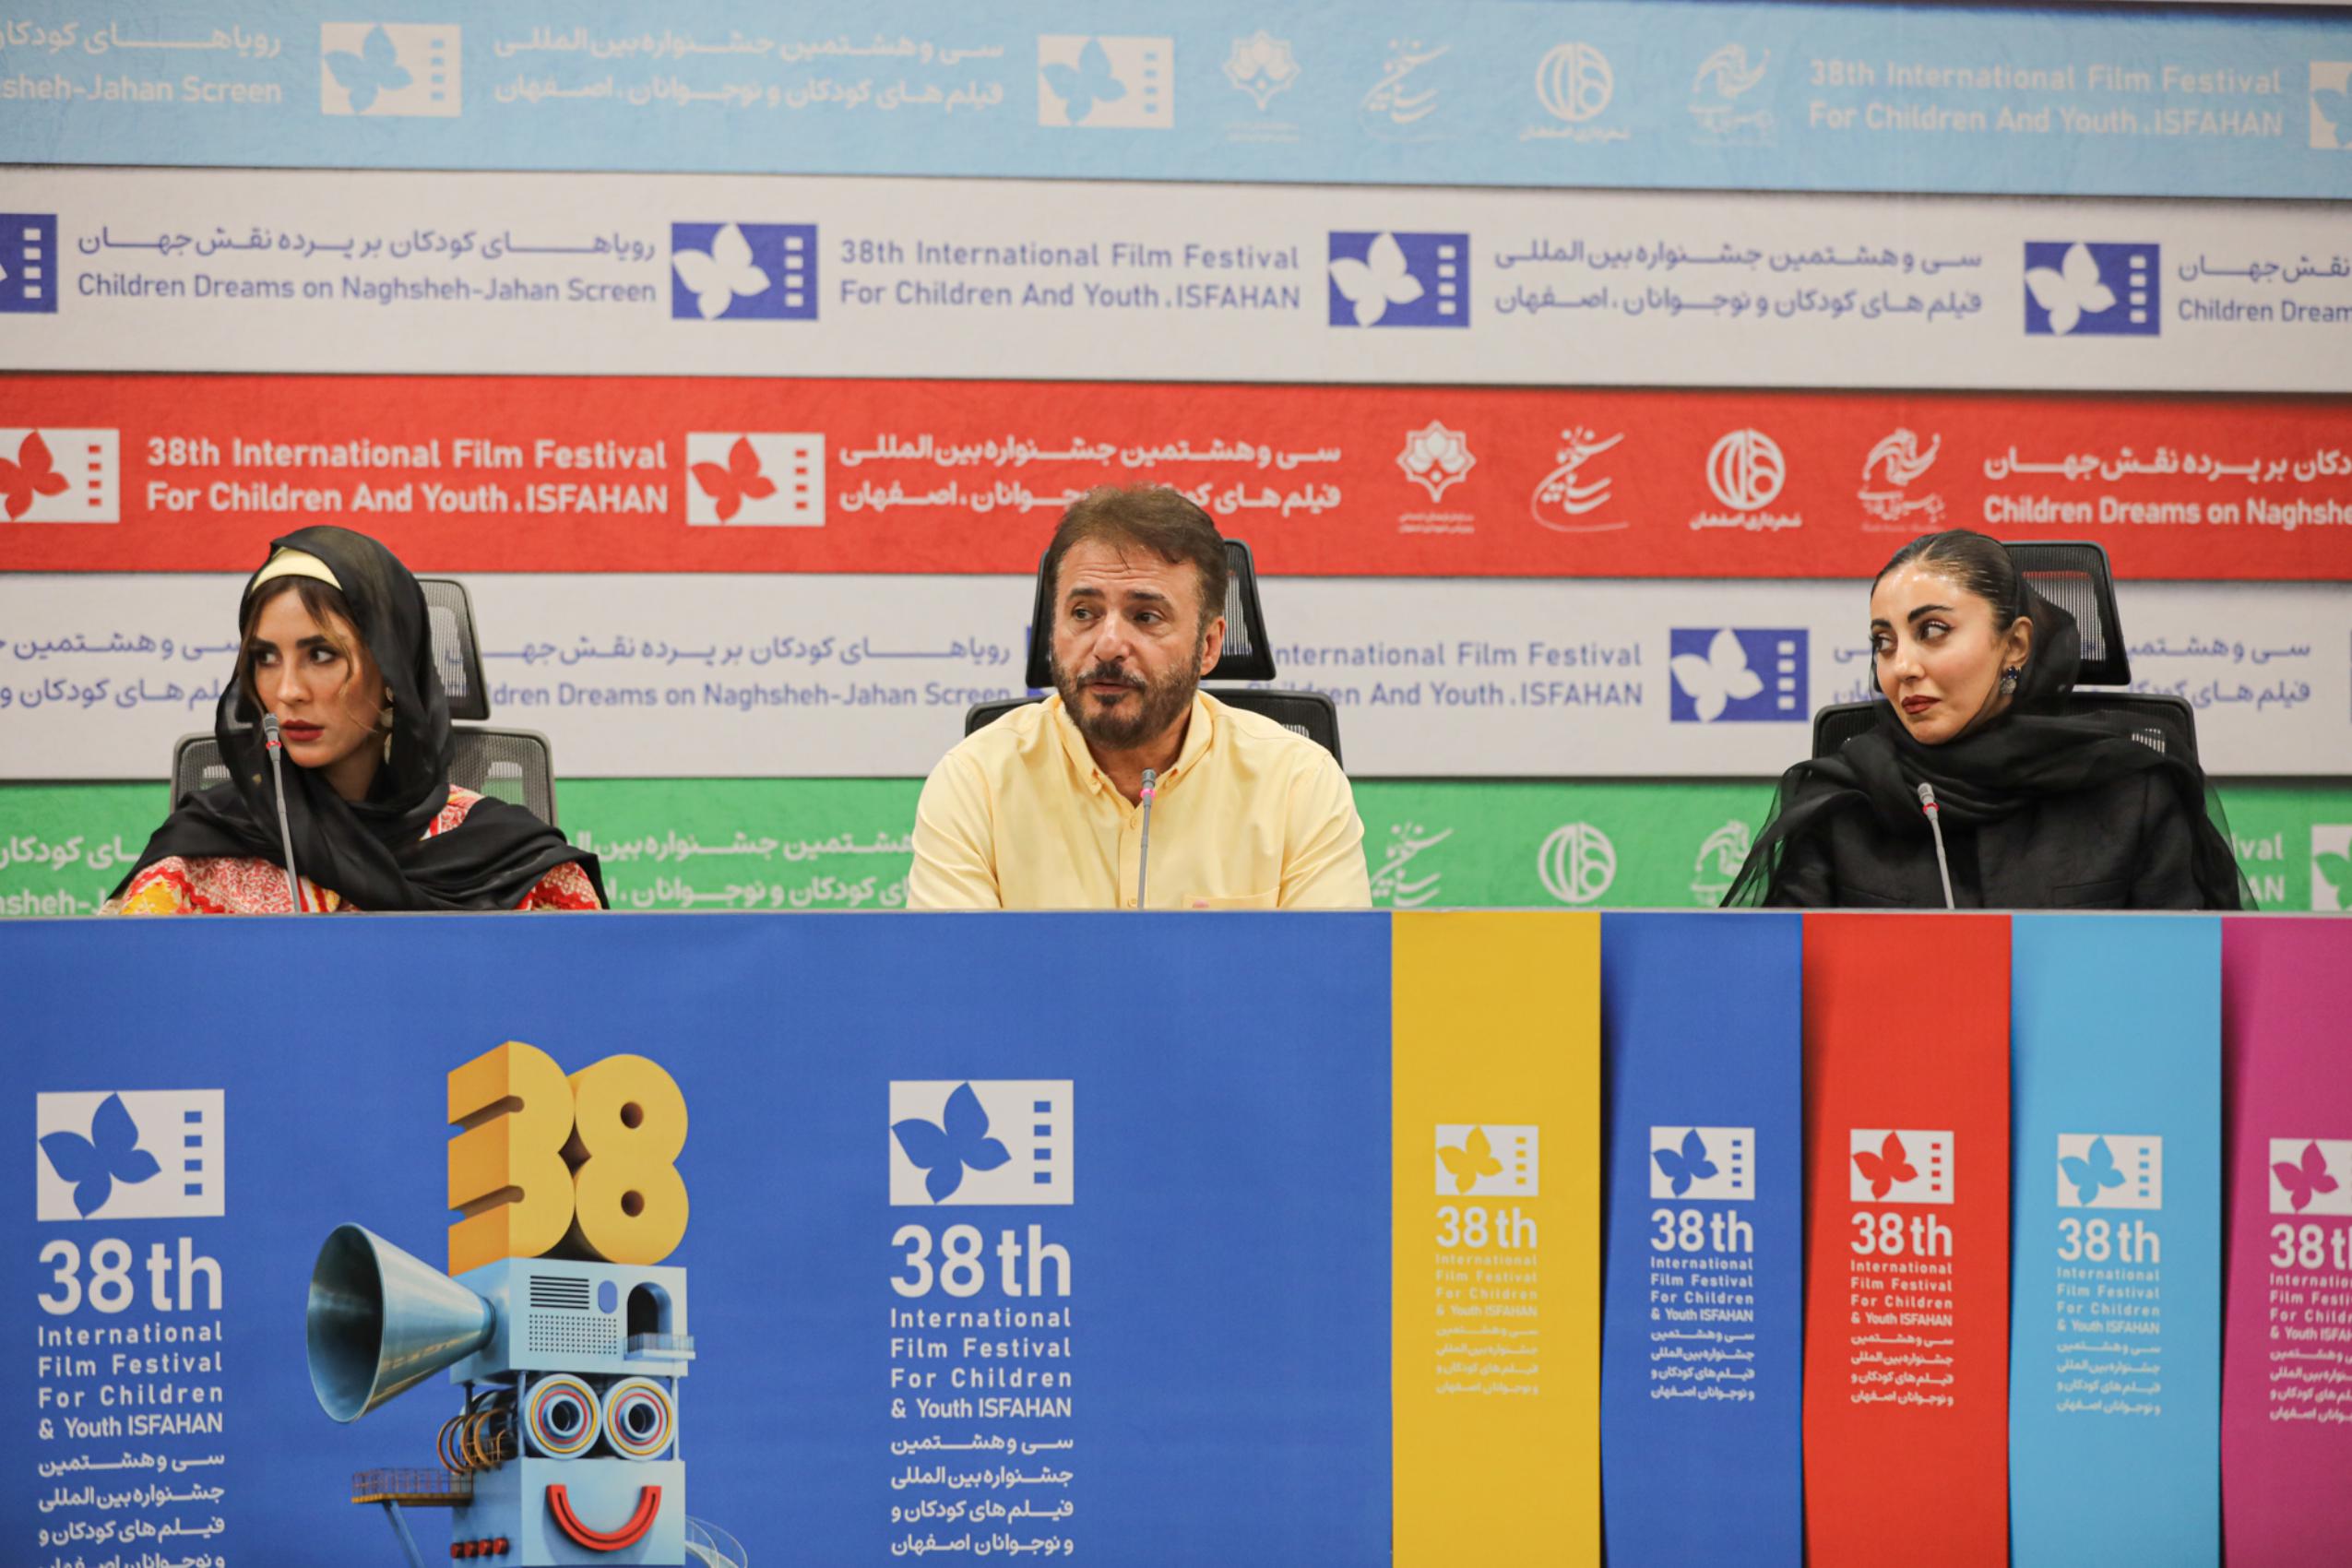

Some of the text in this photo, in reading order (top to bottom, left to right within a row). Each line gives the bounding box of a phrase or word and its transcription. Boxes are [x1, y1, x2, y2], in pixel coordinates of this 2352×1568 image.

[1812, 59, 2280, 93] 38th International Film Festival
[0, 72, 281, 103] sheh-Jahan Screen
[1810, 100, 1857, 128] For
[1866, 102, 1986, 131] Children
[1996, 106, 2049, 132] And
[841, 239, 1298, 269] 38th International Film Festival
[77, 272, 656, 305] Children Dreams on Naghsheh-Jahan Screen
[840, 279, 885, 304] For
[896, 280, 1012, 305] Children
[1022, 282, 1074, 306] And
[2179, 299, 2352, 322] Children Dream
[148, 437, 666, 469] 38th International Film Festival
[148, 481, 200, 510] For
[209, 481, 341, 511] Children
[351, 483, 412, 511] And
[1984, 495, 2239, 524] Children Dreams on
[1458, 643, 1517, 666] Film
[1528, 643, 1642, 666] Festival
[558, 683, 658, 707] Dreams
[665, 689, 695, 707] on
[704, 682, 917, 711] Naghsheh-Jahan
[1372, 683, 1421, 706] And
[448, 1040, 689, 1276] 38
[2271, 1224, 2352, 1269] 38t
[1435, 1253, 1538, 1266] International
[1651, 1255, 1752, 1271] International
[1851, 1259, 1952, 1275] International
[1436, 1268, 1537, 1284] Film Festival
[1651, 1272, 1752, 1289] Film Festival
[1851, 1276, 1952, 1292] Film Festival
[2058, 1266, 2159, 1282] International
[1436, 1286, 1537, 1301] For Children
[1651, 1289, 1753, 1305] For Children
[1851, 1293, 1953, 1310] For Children
[2057, 1283, 2158, 1300] Film Festival
[2270, 1289, 2303, 1304] Film
[891, 1307, 1070, 1327] International
[1651, 1307, 1753, 1323] & Youth ISFAHAN
[1851, 1311, 1953, 1327] & Youth ISFAHAN
[2057, 1301, 2159, 1317] For Children
[2270, 1307, 2296, 1322] For
[39, 1321, 221, 1347] International
[2073, 1320, 2159, 1335] Youth ISFAHAN
[2286, 1326, 2317, 1340] Youth
[891, 1337, 1070, 1358] Film Festival
[39, 1351, 221, 1377] Film Festival
[891, 1368, 1071, 1388] For Children
[39, 1384, 222, 1408] For Children
[891, 1397, 1071, 1418] & Youth ISFAHAN
[39, 1412, 222, 1440] & Youth ISFAHAN
